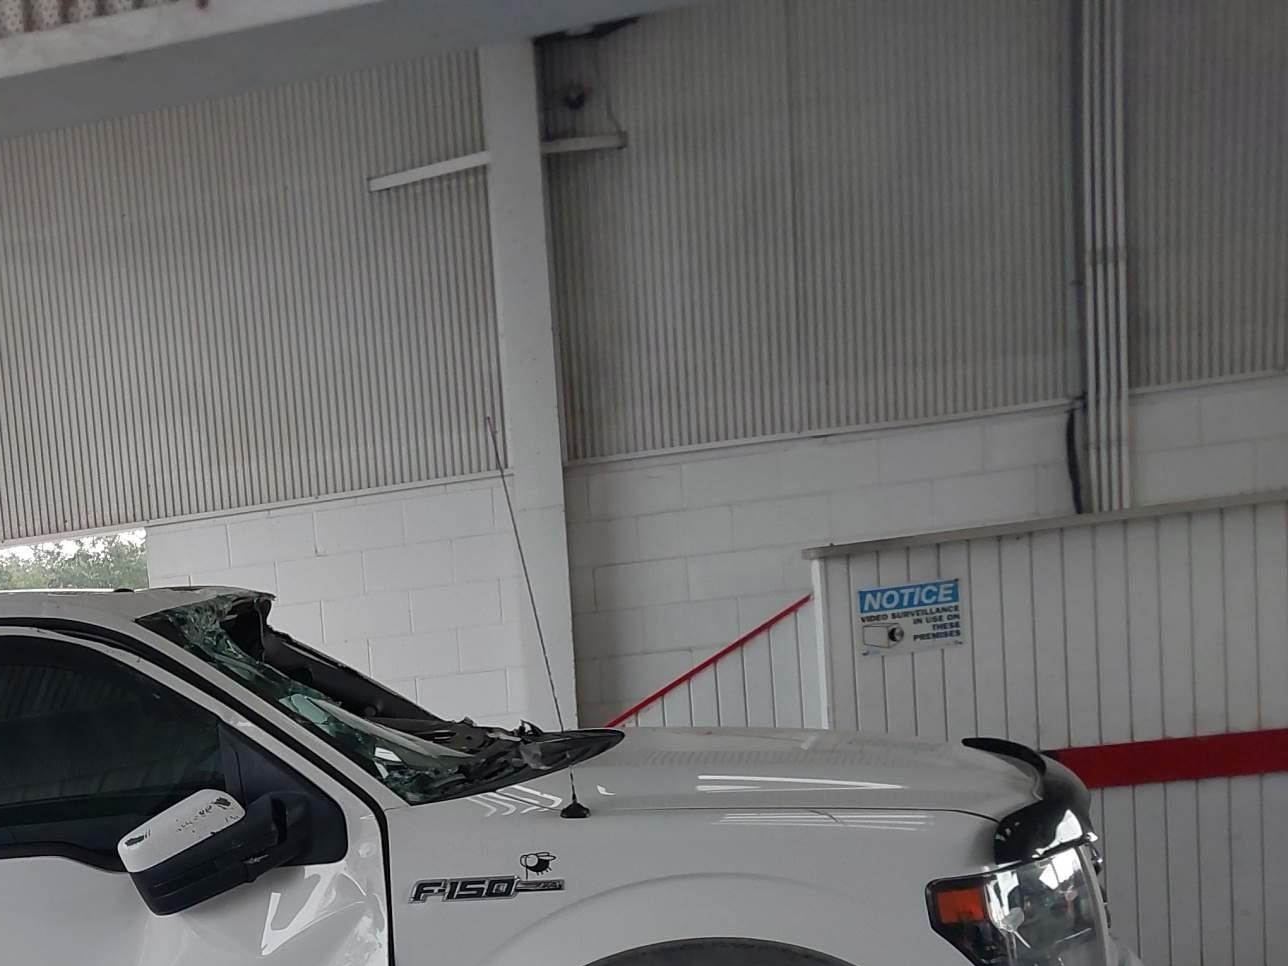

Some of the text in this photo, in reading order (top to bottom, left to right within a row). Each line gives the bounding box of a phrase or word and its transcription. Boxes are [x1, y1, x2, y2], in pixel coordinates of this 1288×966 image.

[863, 583, 955, 612] NOTICE
[861, 605, 960, 623] VIDEO SURVEILLANCE
[925, 615, 943, 624] USE
[947, 613, 961, 621] ON
[932, 621, 961, 631] THESE
[913, 629, 961, 641] PREMISES
[410, 875, 519, 903] F-150
